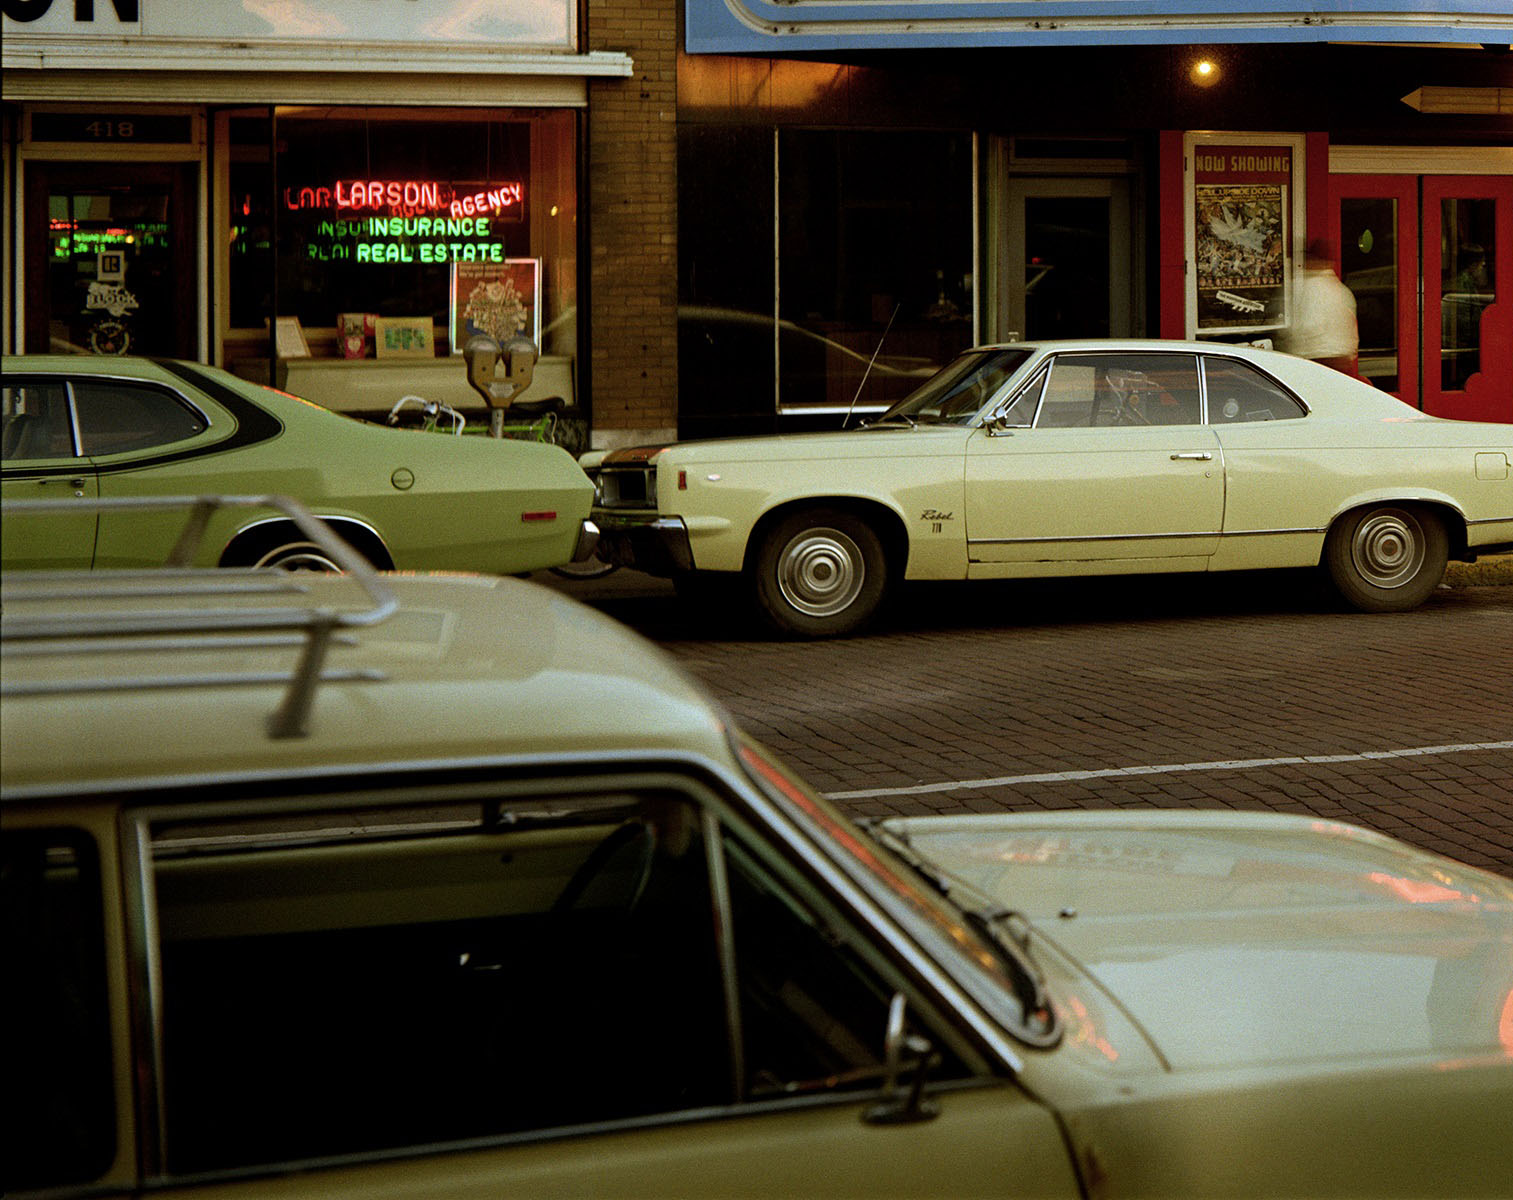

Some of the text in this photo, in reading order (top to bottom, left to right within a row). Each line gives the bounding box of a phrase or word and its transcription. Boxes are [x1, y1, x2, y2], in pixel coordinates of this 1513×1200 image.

[85, 121, 134, 138] 418
[1196, 156, 1290, 172] NOW SHOWING
[337, 180, 438, 207] LARSON
[450, 183, 522, 220] AGENCY
[369, 218, 490, 237] INSURANCE
[356, 243, 413, 263] REAL
[420, 243, 504, 263] ESTATE
[920, 509, 955, 521] Rebel
